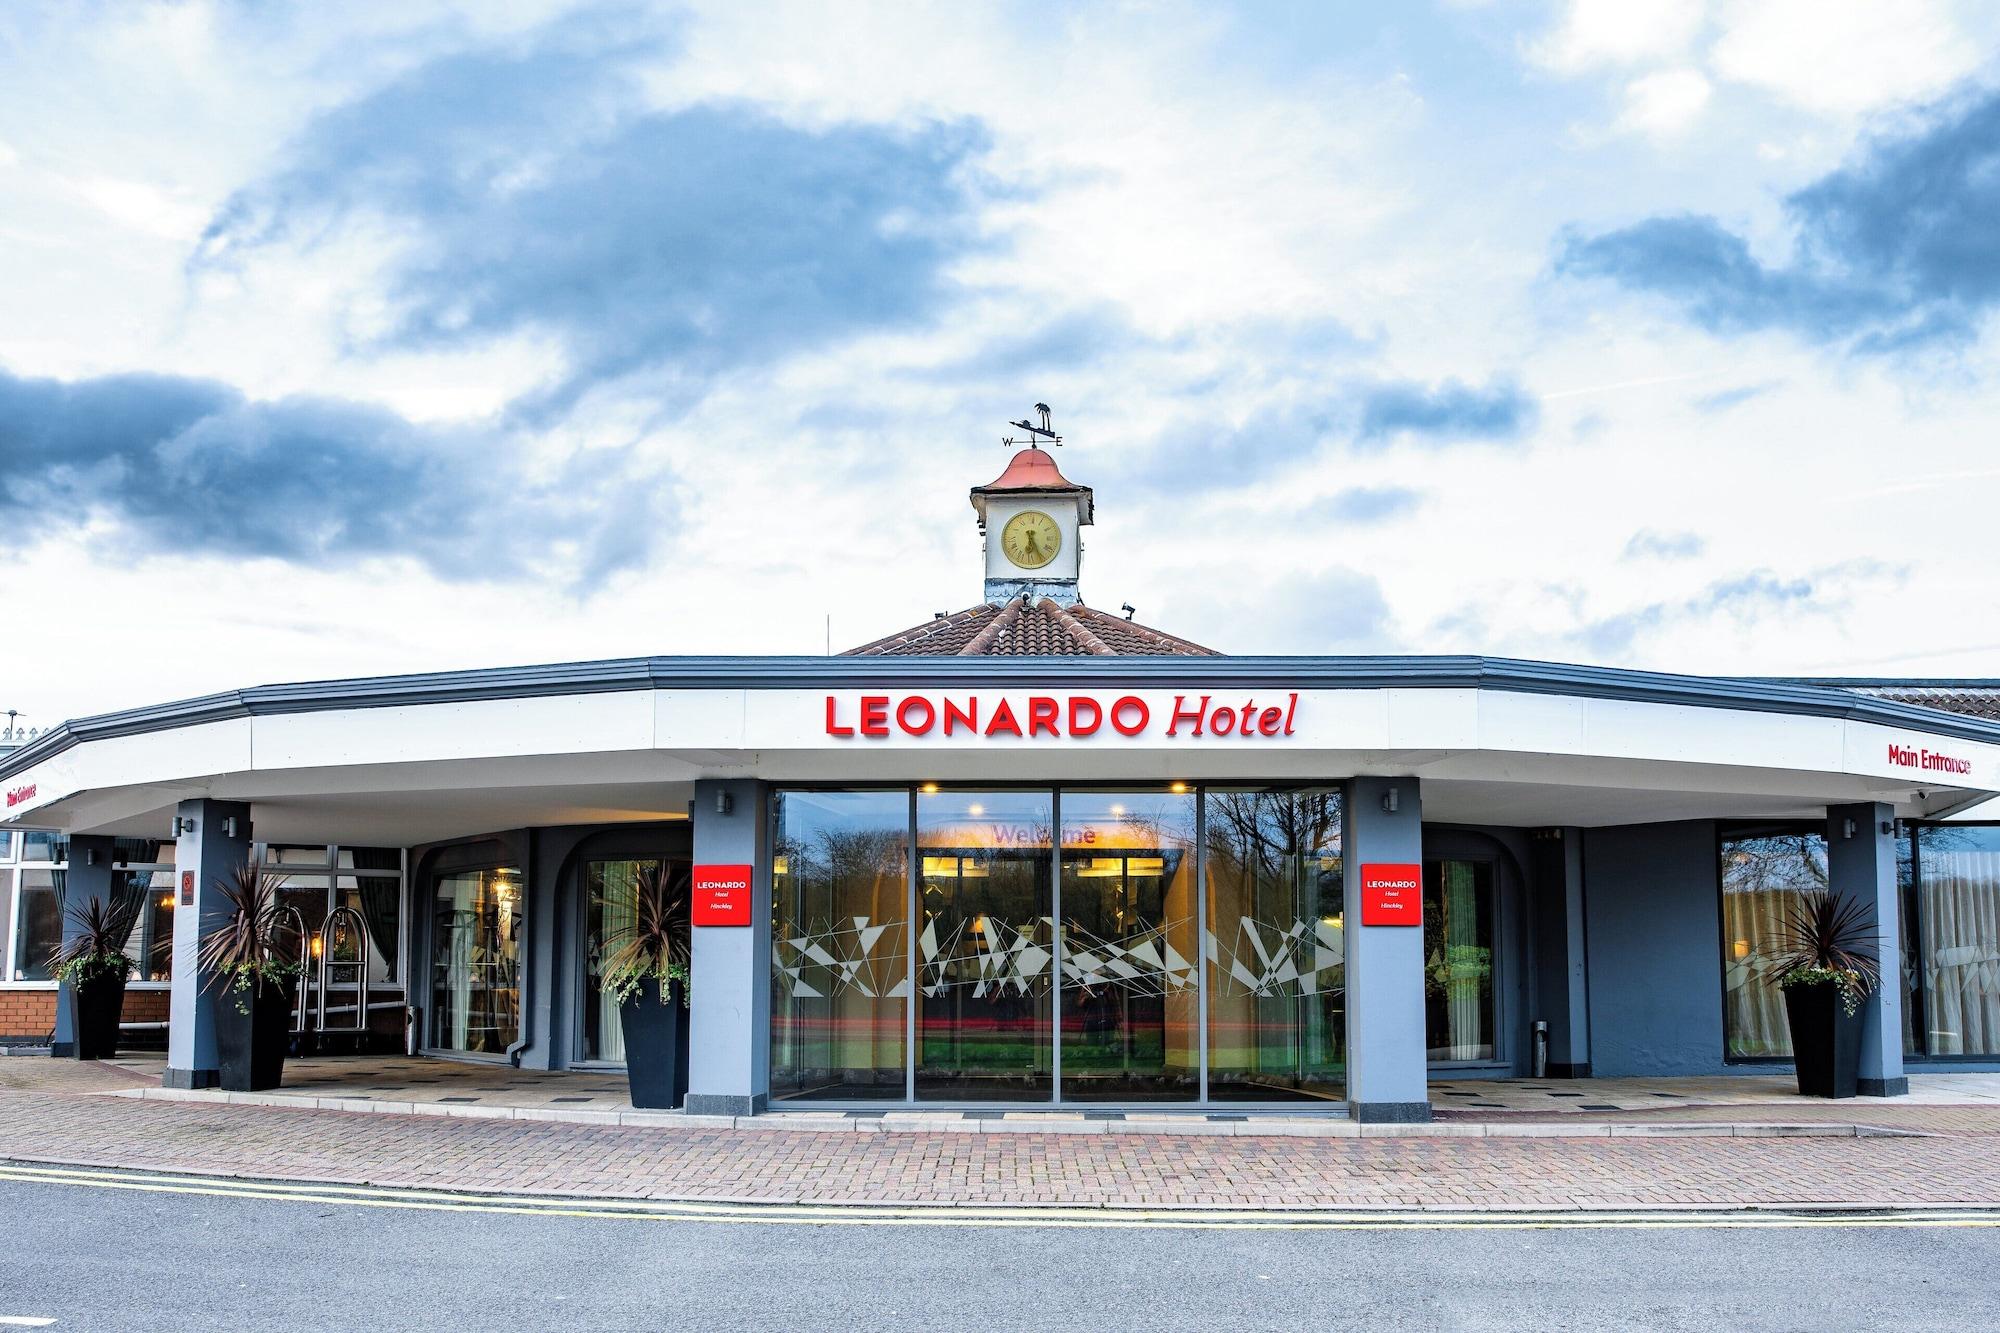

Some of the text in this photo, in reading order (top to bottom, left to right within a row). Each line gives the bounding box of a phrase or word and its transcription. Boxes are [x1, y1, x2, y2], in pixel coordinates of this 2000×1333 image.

[1002, 437, 1014, 447] W
[1055, 436, 1063, 447] E
[825, 693, 1299, 737] LEONARDO Hotel
[1888, 744, 1972, 775] Main Entrance
[697, 881, 746, 889] LEONARDO
[1367, 880, 1417, 888] LEONARDO
[1380, 902, 1404, 910] Hinckley
